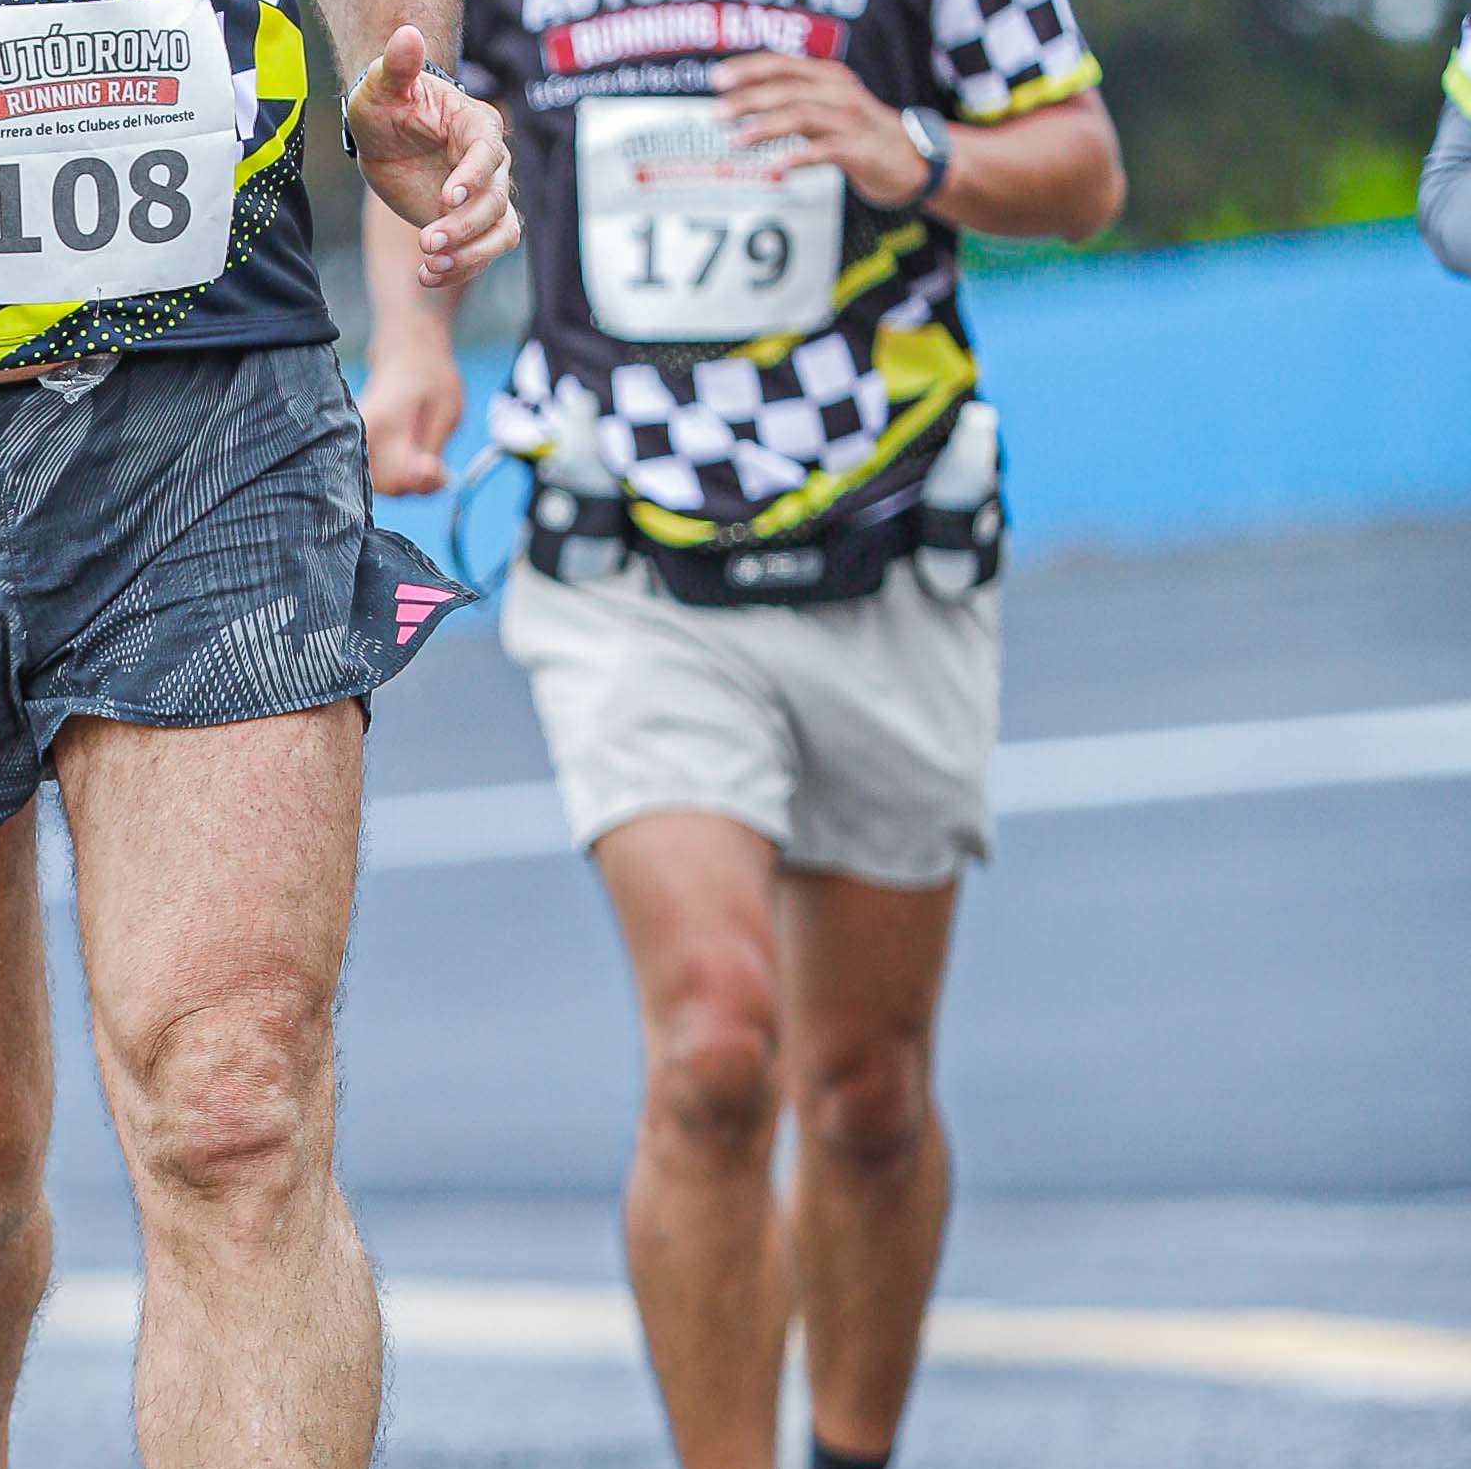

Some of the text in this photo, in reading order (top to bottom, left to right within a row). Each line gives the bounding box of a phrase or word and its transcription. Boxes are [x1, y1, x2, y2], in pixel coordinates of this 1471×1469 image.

[6, 80, 159, 117] RUNNING RACE
[35, 122, 53, 136] de
[56, 119, 75, 135] los
[77, 117, 120, 134] Clubes
[122, 114, 142, 128] del
[144, 110, 195, 127] Noroeste
[628, 216, 792, 290] 179
